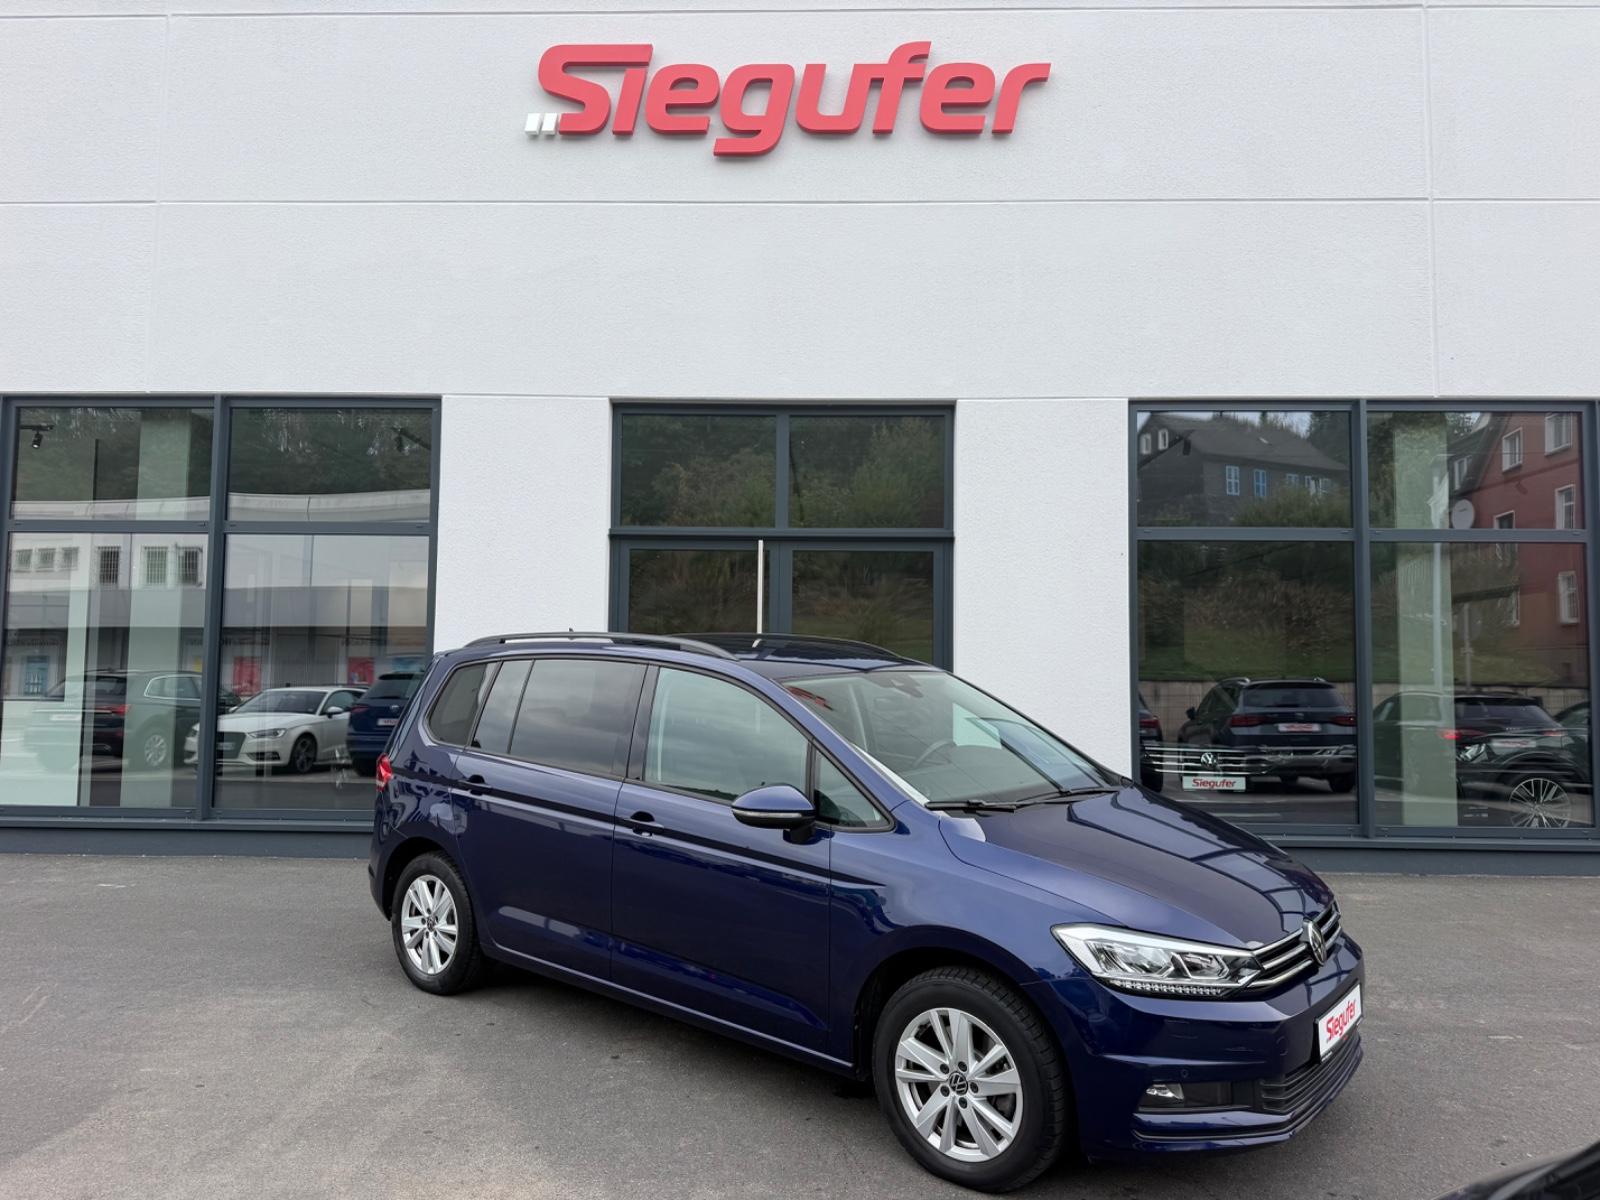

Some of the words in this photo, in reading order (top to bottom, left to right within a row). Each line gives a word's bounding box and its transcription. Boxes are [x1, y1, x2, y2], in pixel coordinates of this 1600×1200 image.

[537, 40, 1052, 157] Siegufer
[1192, 778, 1237, 788] Siegufer
[1325, 999, 1357, 1041] Siegufer
